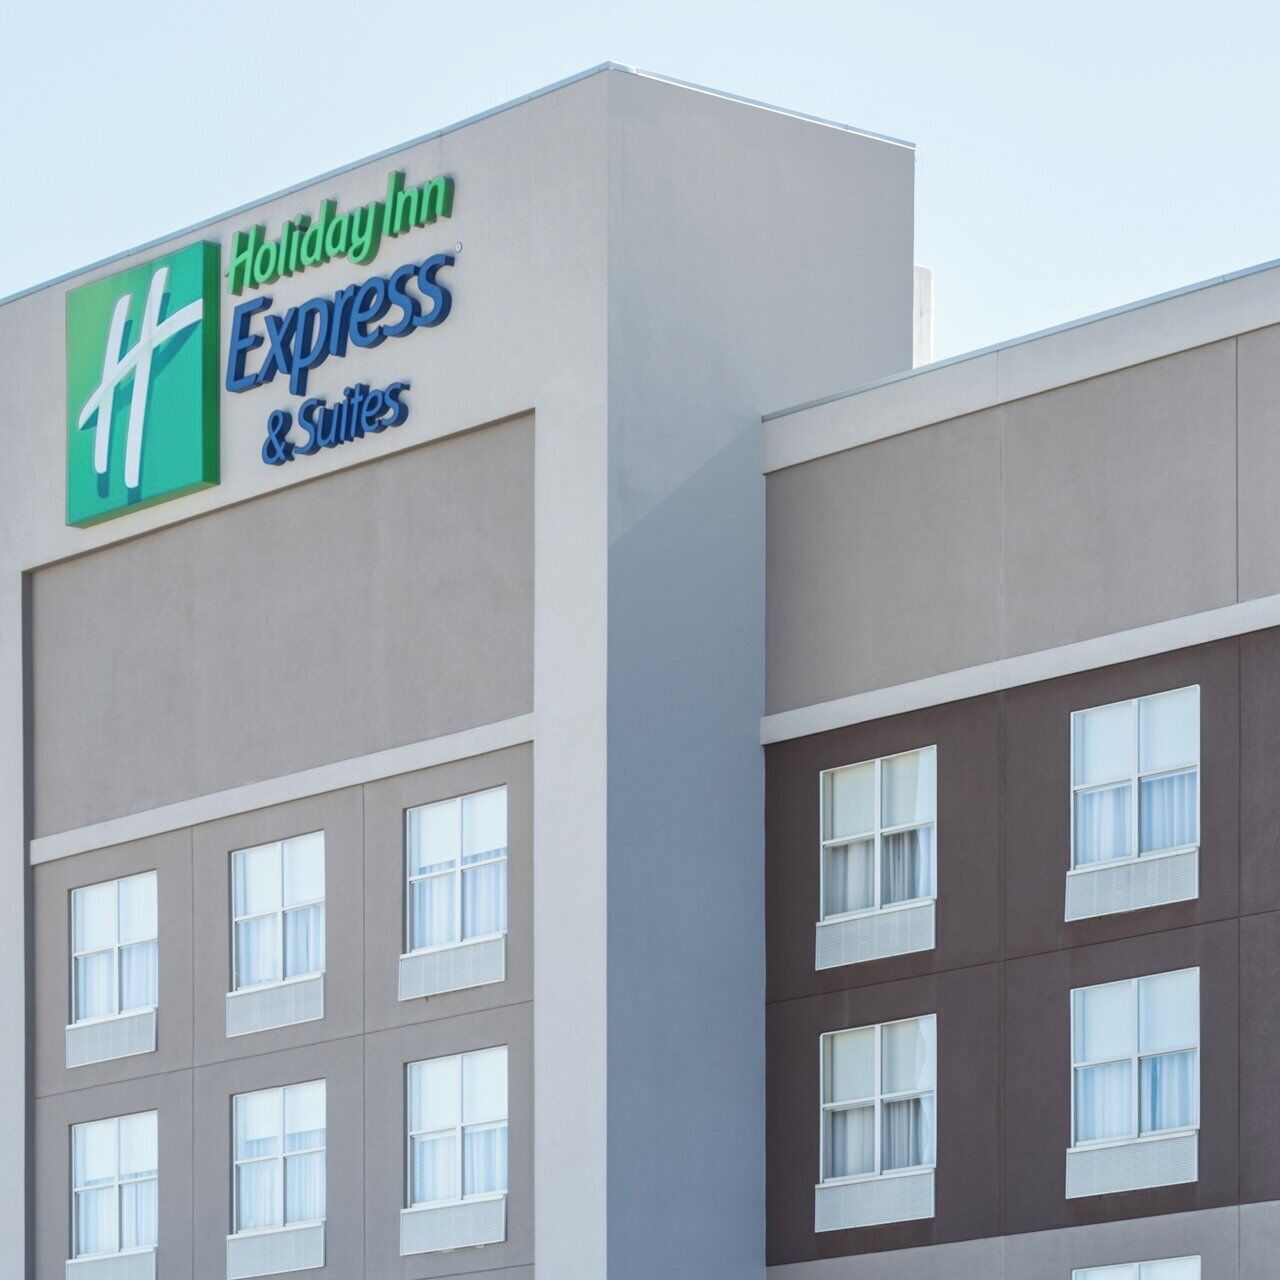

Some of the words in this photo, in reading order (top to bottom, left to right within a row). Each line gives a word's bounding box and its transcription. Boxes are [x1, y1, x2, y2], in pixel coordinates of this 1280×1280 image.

[226, 199, 382, 296] Holiday
[381, 170, 455, 239] Inn
[226, 254, 455, 397] Express
[262, 409, 295, 466] &
[294, 382, 410, 456] Suites
